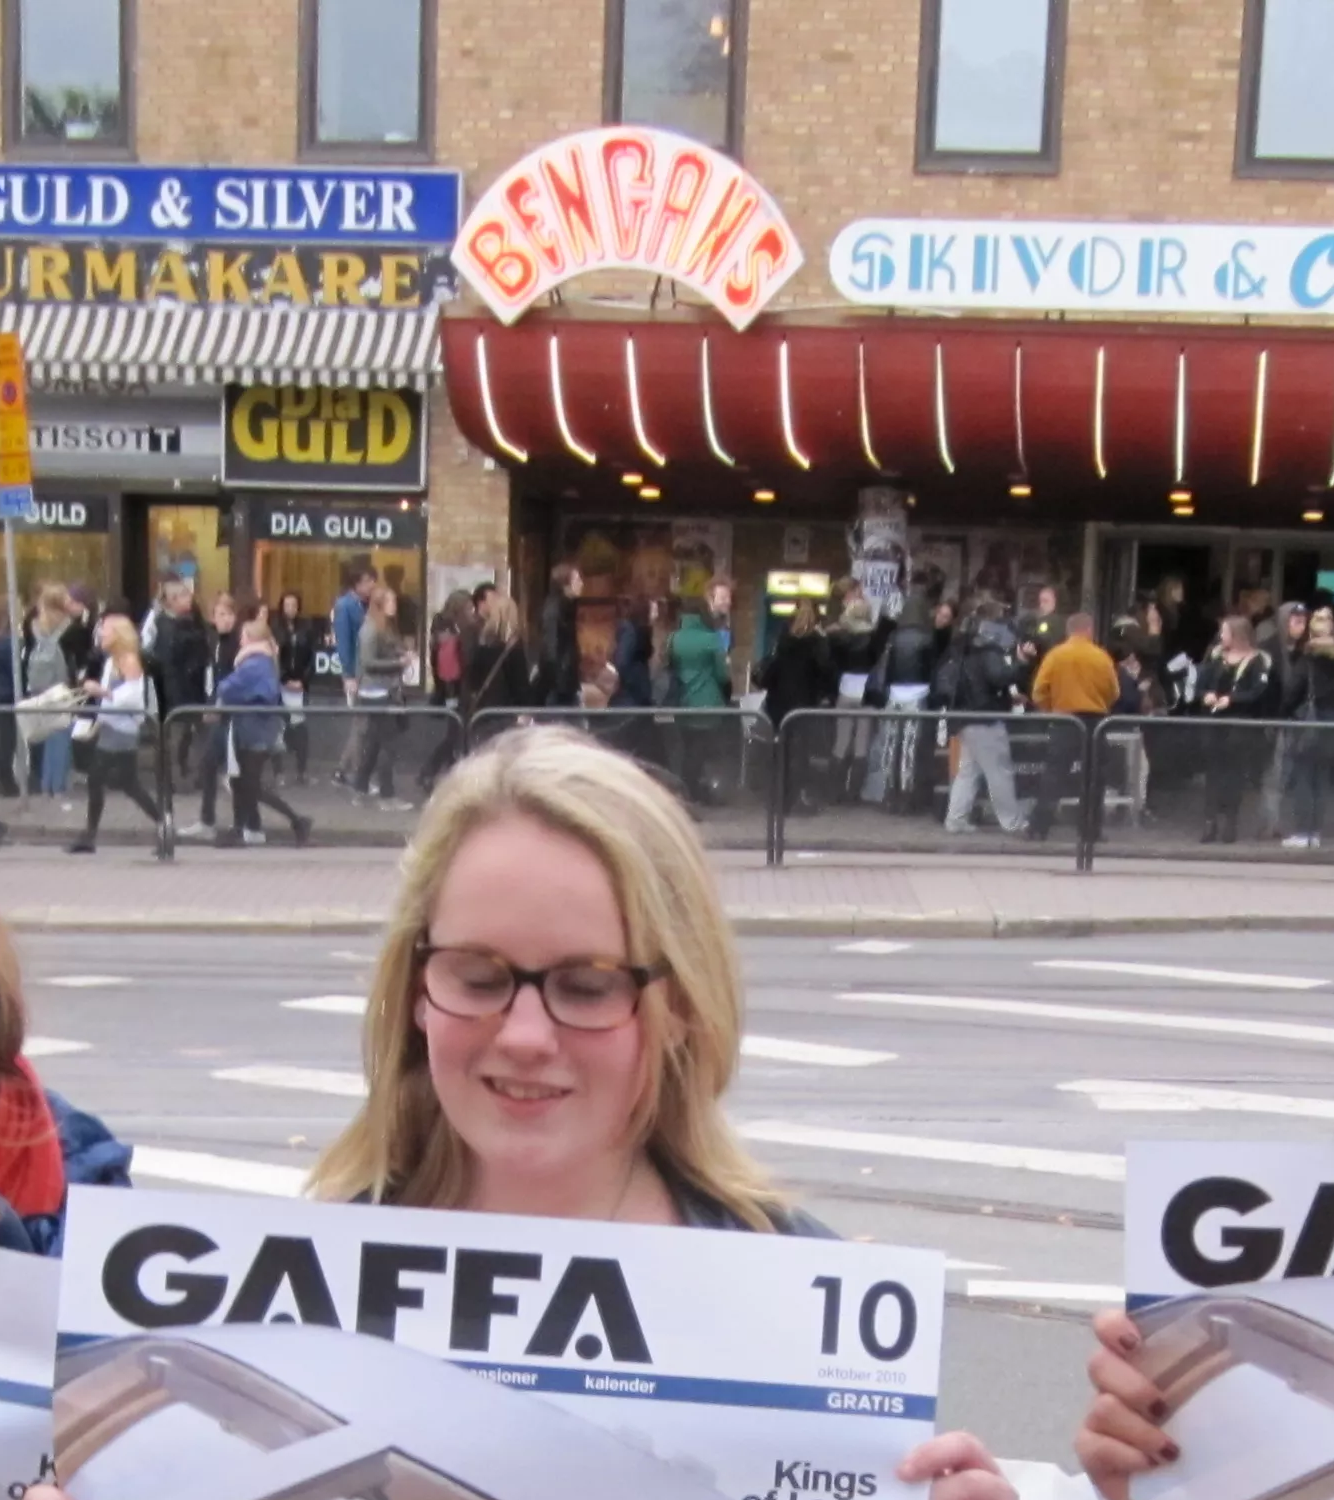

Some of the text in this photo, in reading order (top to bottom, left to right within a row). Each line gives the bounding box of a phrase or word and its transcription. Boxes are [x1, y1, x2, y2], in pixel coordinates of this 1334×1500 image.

[150, 176, 192, 228] &
[214, 178, 418, 232] SILVER
[468, 136, 789, 307] BENGANS
[848, 231, 1188, 297] SKIVOR
[1214, 239, 1266, 299] &
[33, 427, 148, 452] TISSOT
[232, 387, 412, 465] GULD
[270, 512, 393, 541] DIA GULD
[101, 1223, 654, 1365] GAFFA
[810, 1274, 918, 1362] 10
[584, 1373, 657, 1395] kalender
[817, 1366, 907, 1385] oktober 2010
[827, 1391, 905, 1414] GRATIS
[774, 1459, 877, 1500] Kings
